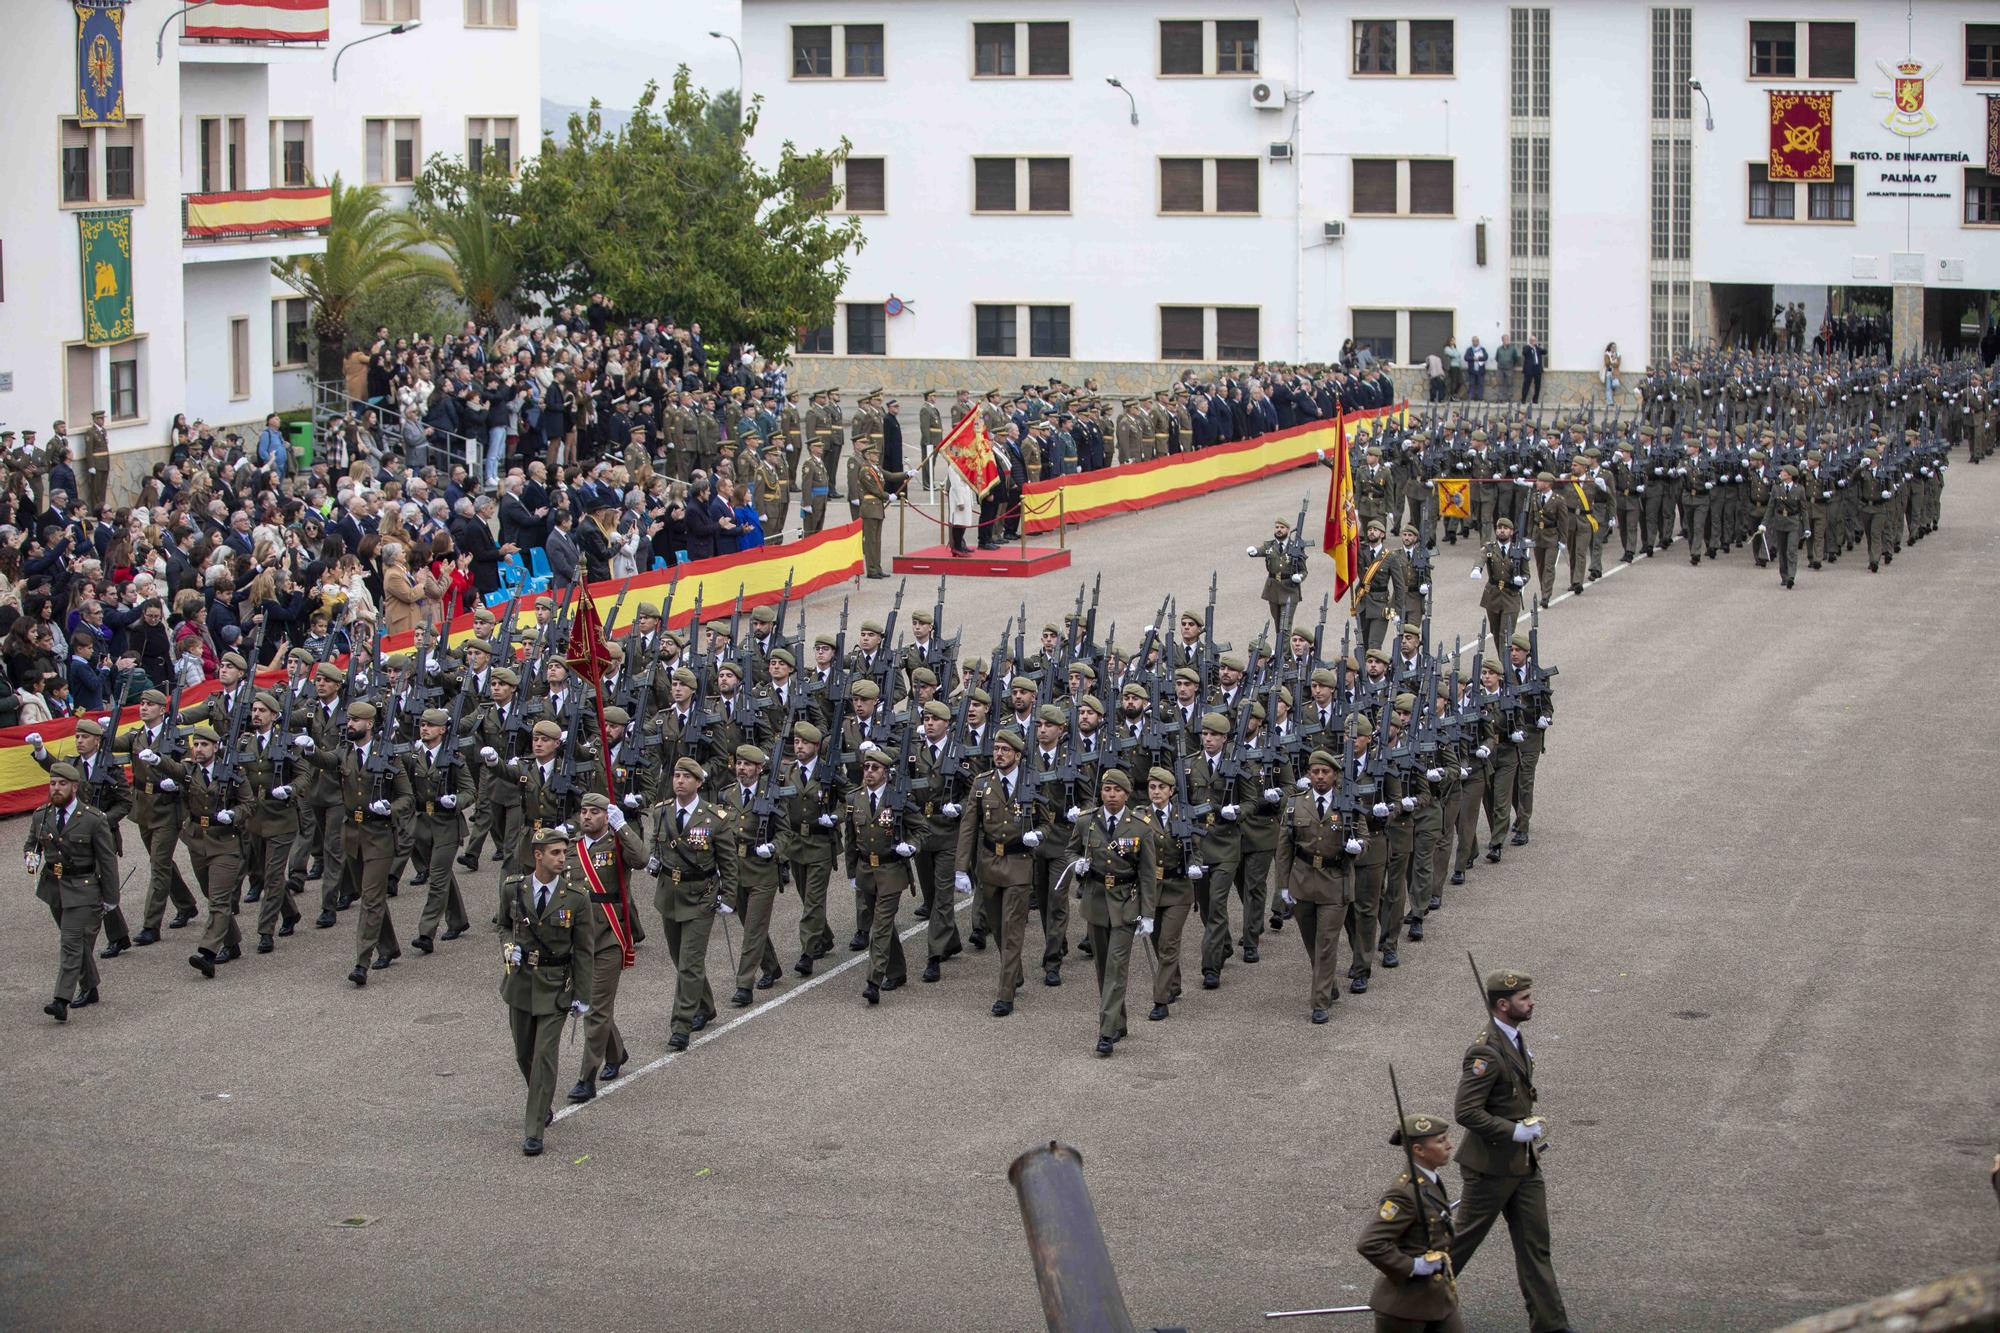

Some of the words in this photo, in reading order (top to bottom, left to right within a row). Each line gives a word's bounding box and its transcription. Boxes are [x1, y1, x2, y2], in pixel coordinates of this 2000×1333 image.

[1850, 151, 1882, 160] RGTO.
[1886, 152, 1901, 161] DE
[1903, 151, 1969, 162] INFANTERÍA
[1881, 173, 1921, 182] PALMA
[1924, 174, 1937, 183] 47
